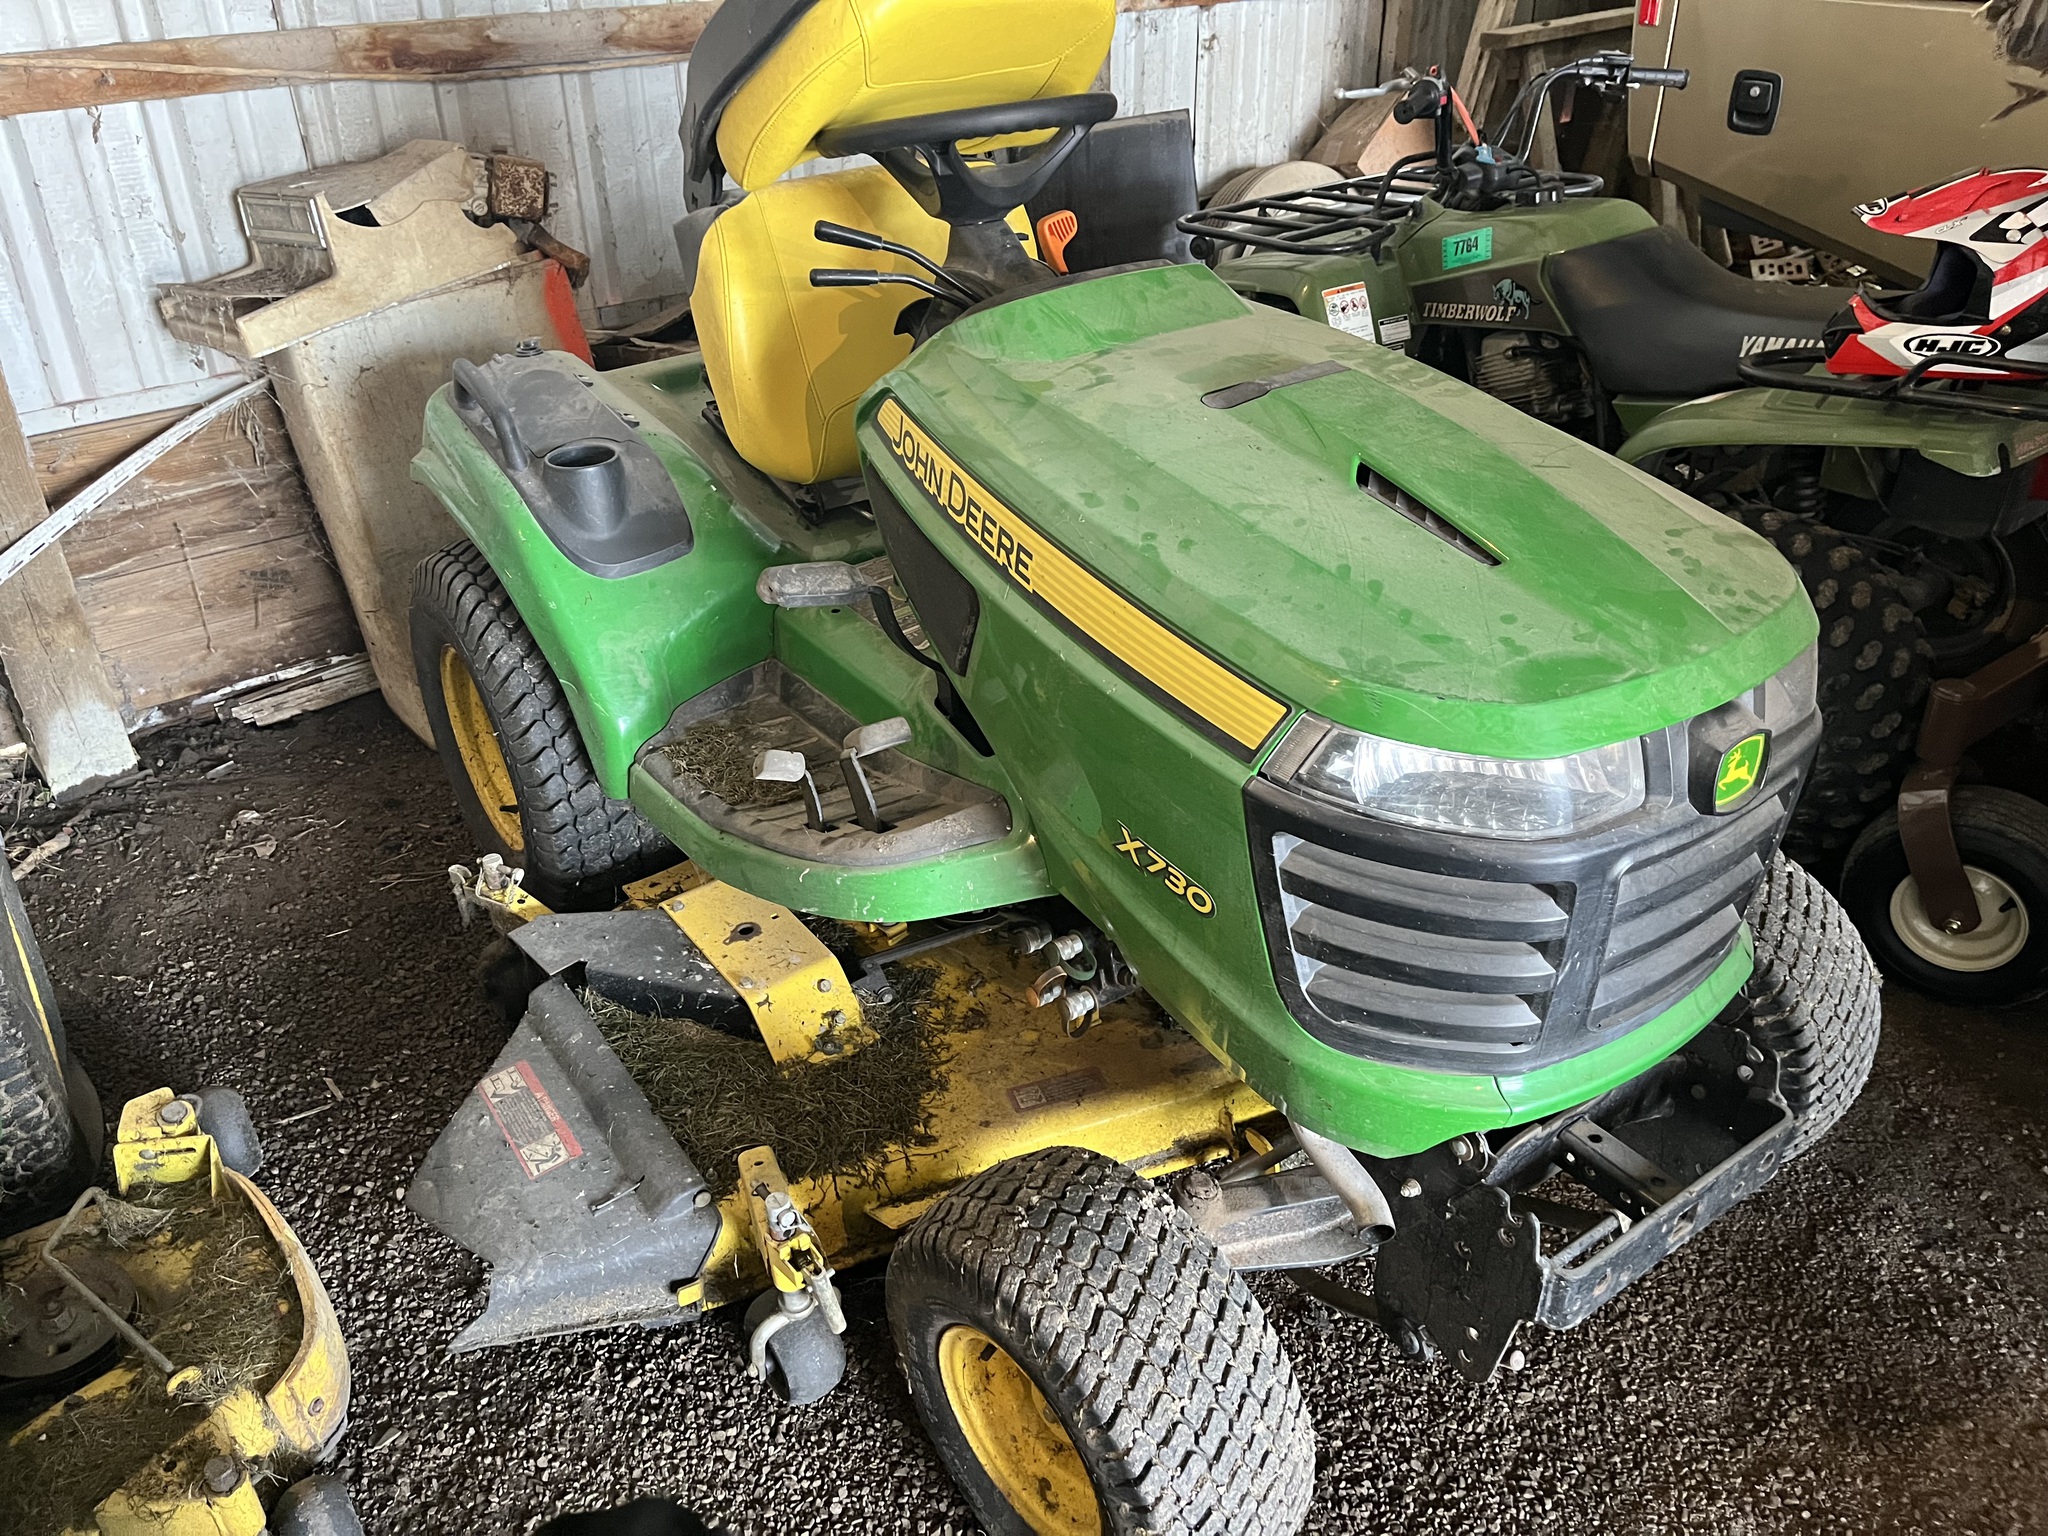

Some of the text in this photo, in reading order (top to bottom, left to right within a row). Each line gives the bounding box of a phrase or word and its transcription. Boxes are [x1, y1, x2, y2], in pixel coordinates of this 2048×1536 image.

[1453, 236, 1479, 257] 7764
[1422, 302, 1517, 322] TIMBERWOLF
[1913, 338, 1987, 353] HJC
[892, 415, 1033, 586] JOHN DEERE
[1115, 826, 1213, 914] X730
